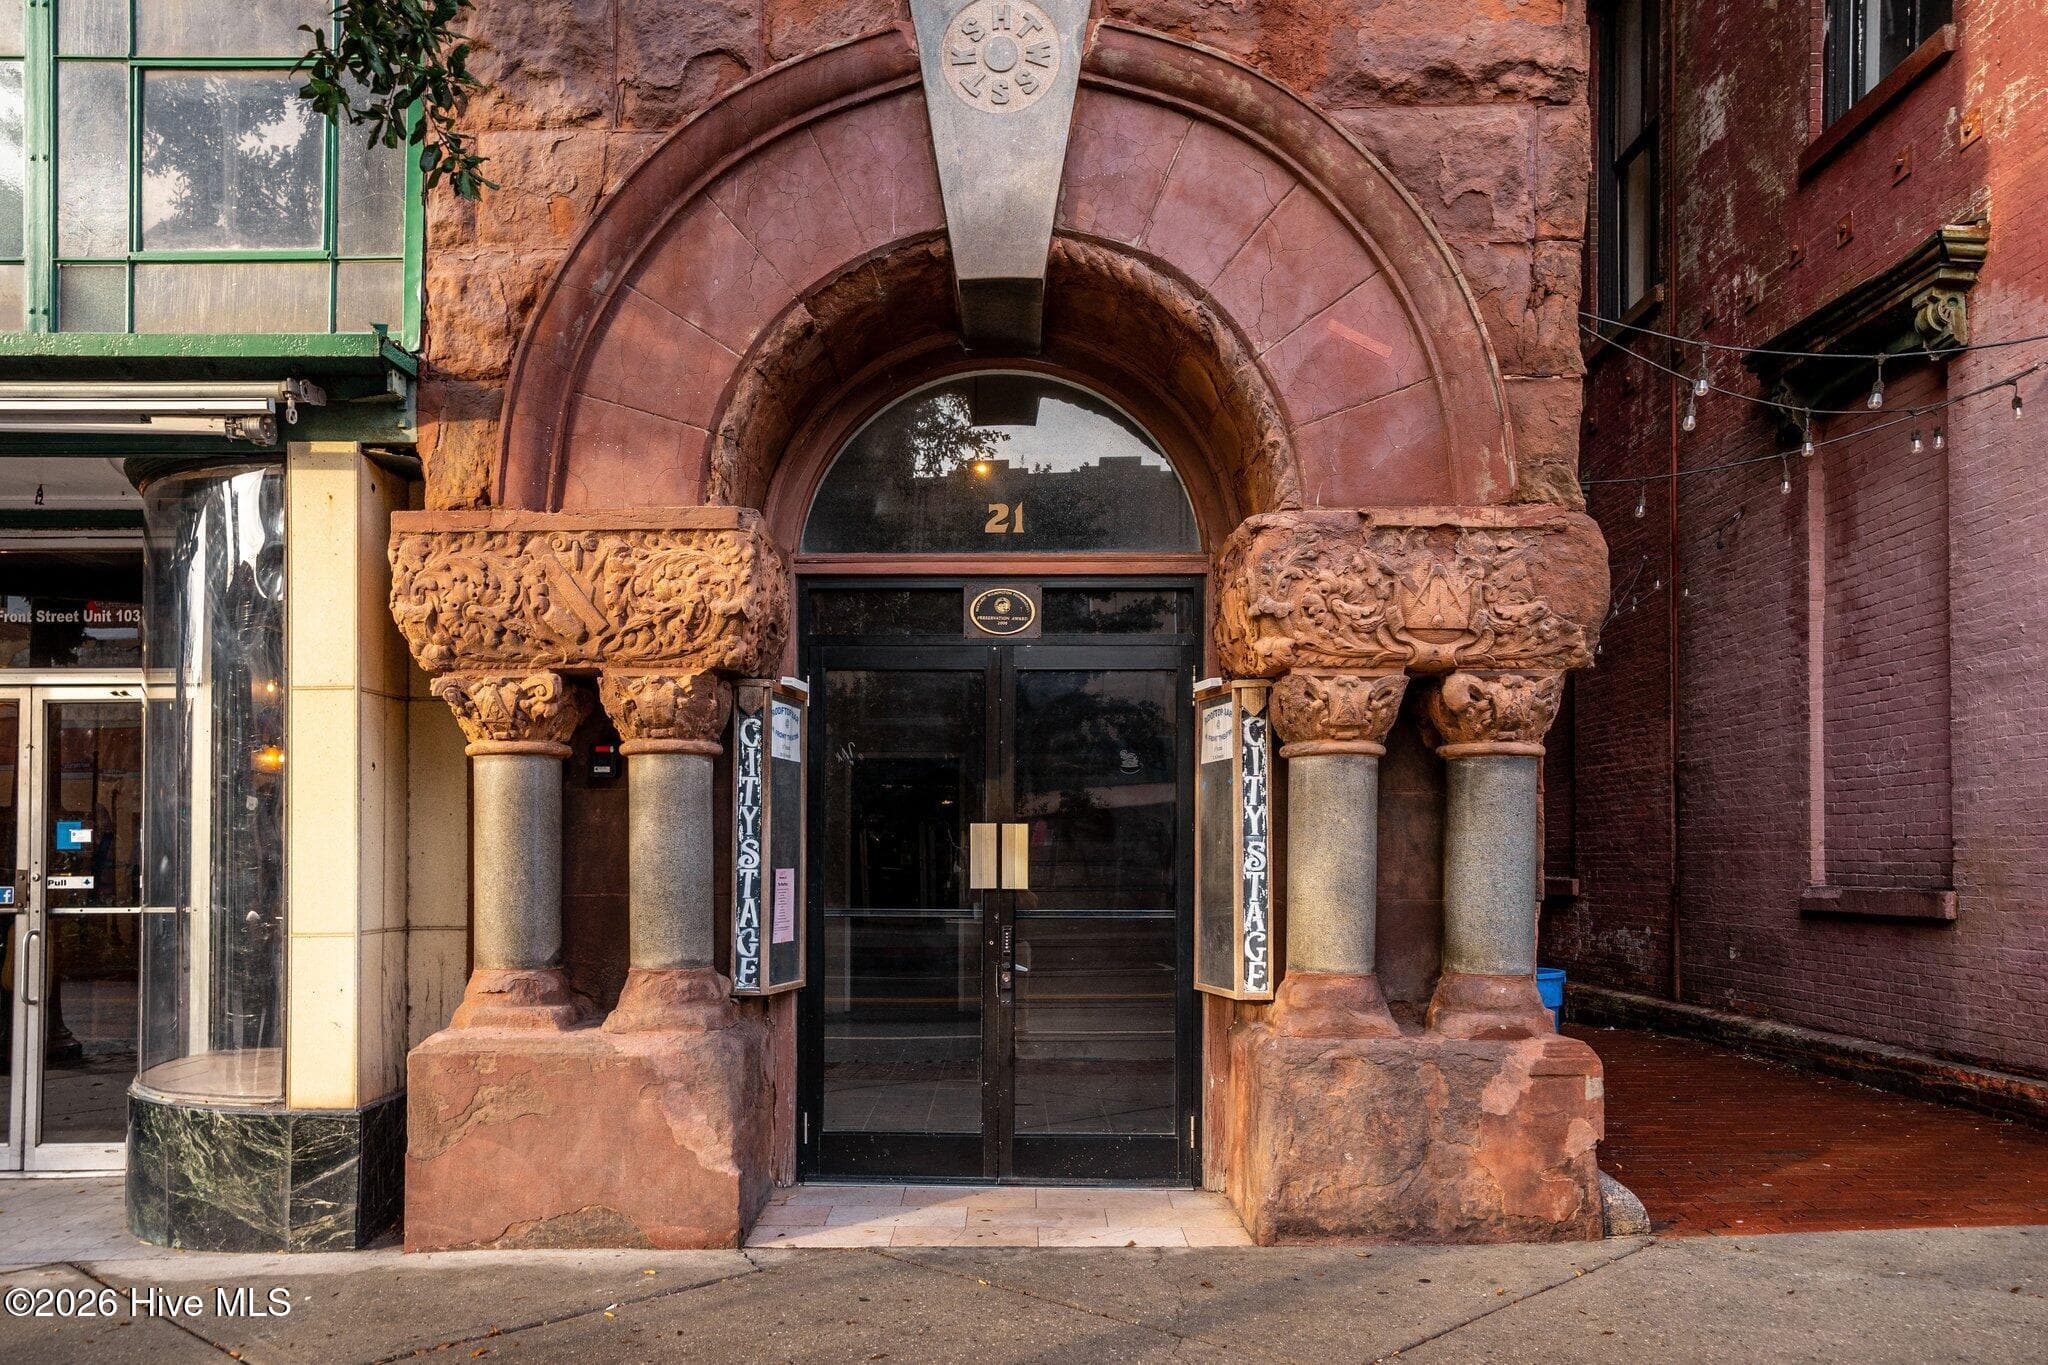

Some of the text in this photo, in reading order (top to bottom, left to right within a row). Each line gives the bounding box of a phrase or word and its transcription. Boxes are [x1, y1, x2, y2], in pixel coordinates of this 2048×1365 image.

[984, 501, 1025, 534] 21
[36, 610, 79, 623] Street
[83, 609, 112, 622] Unit
[116, 609, 141, 622] 103
[48, 879, 67, 887] Pull
